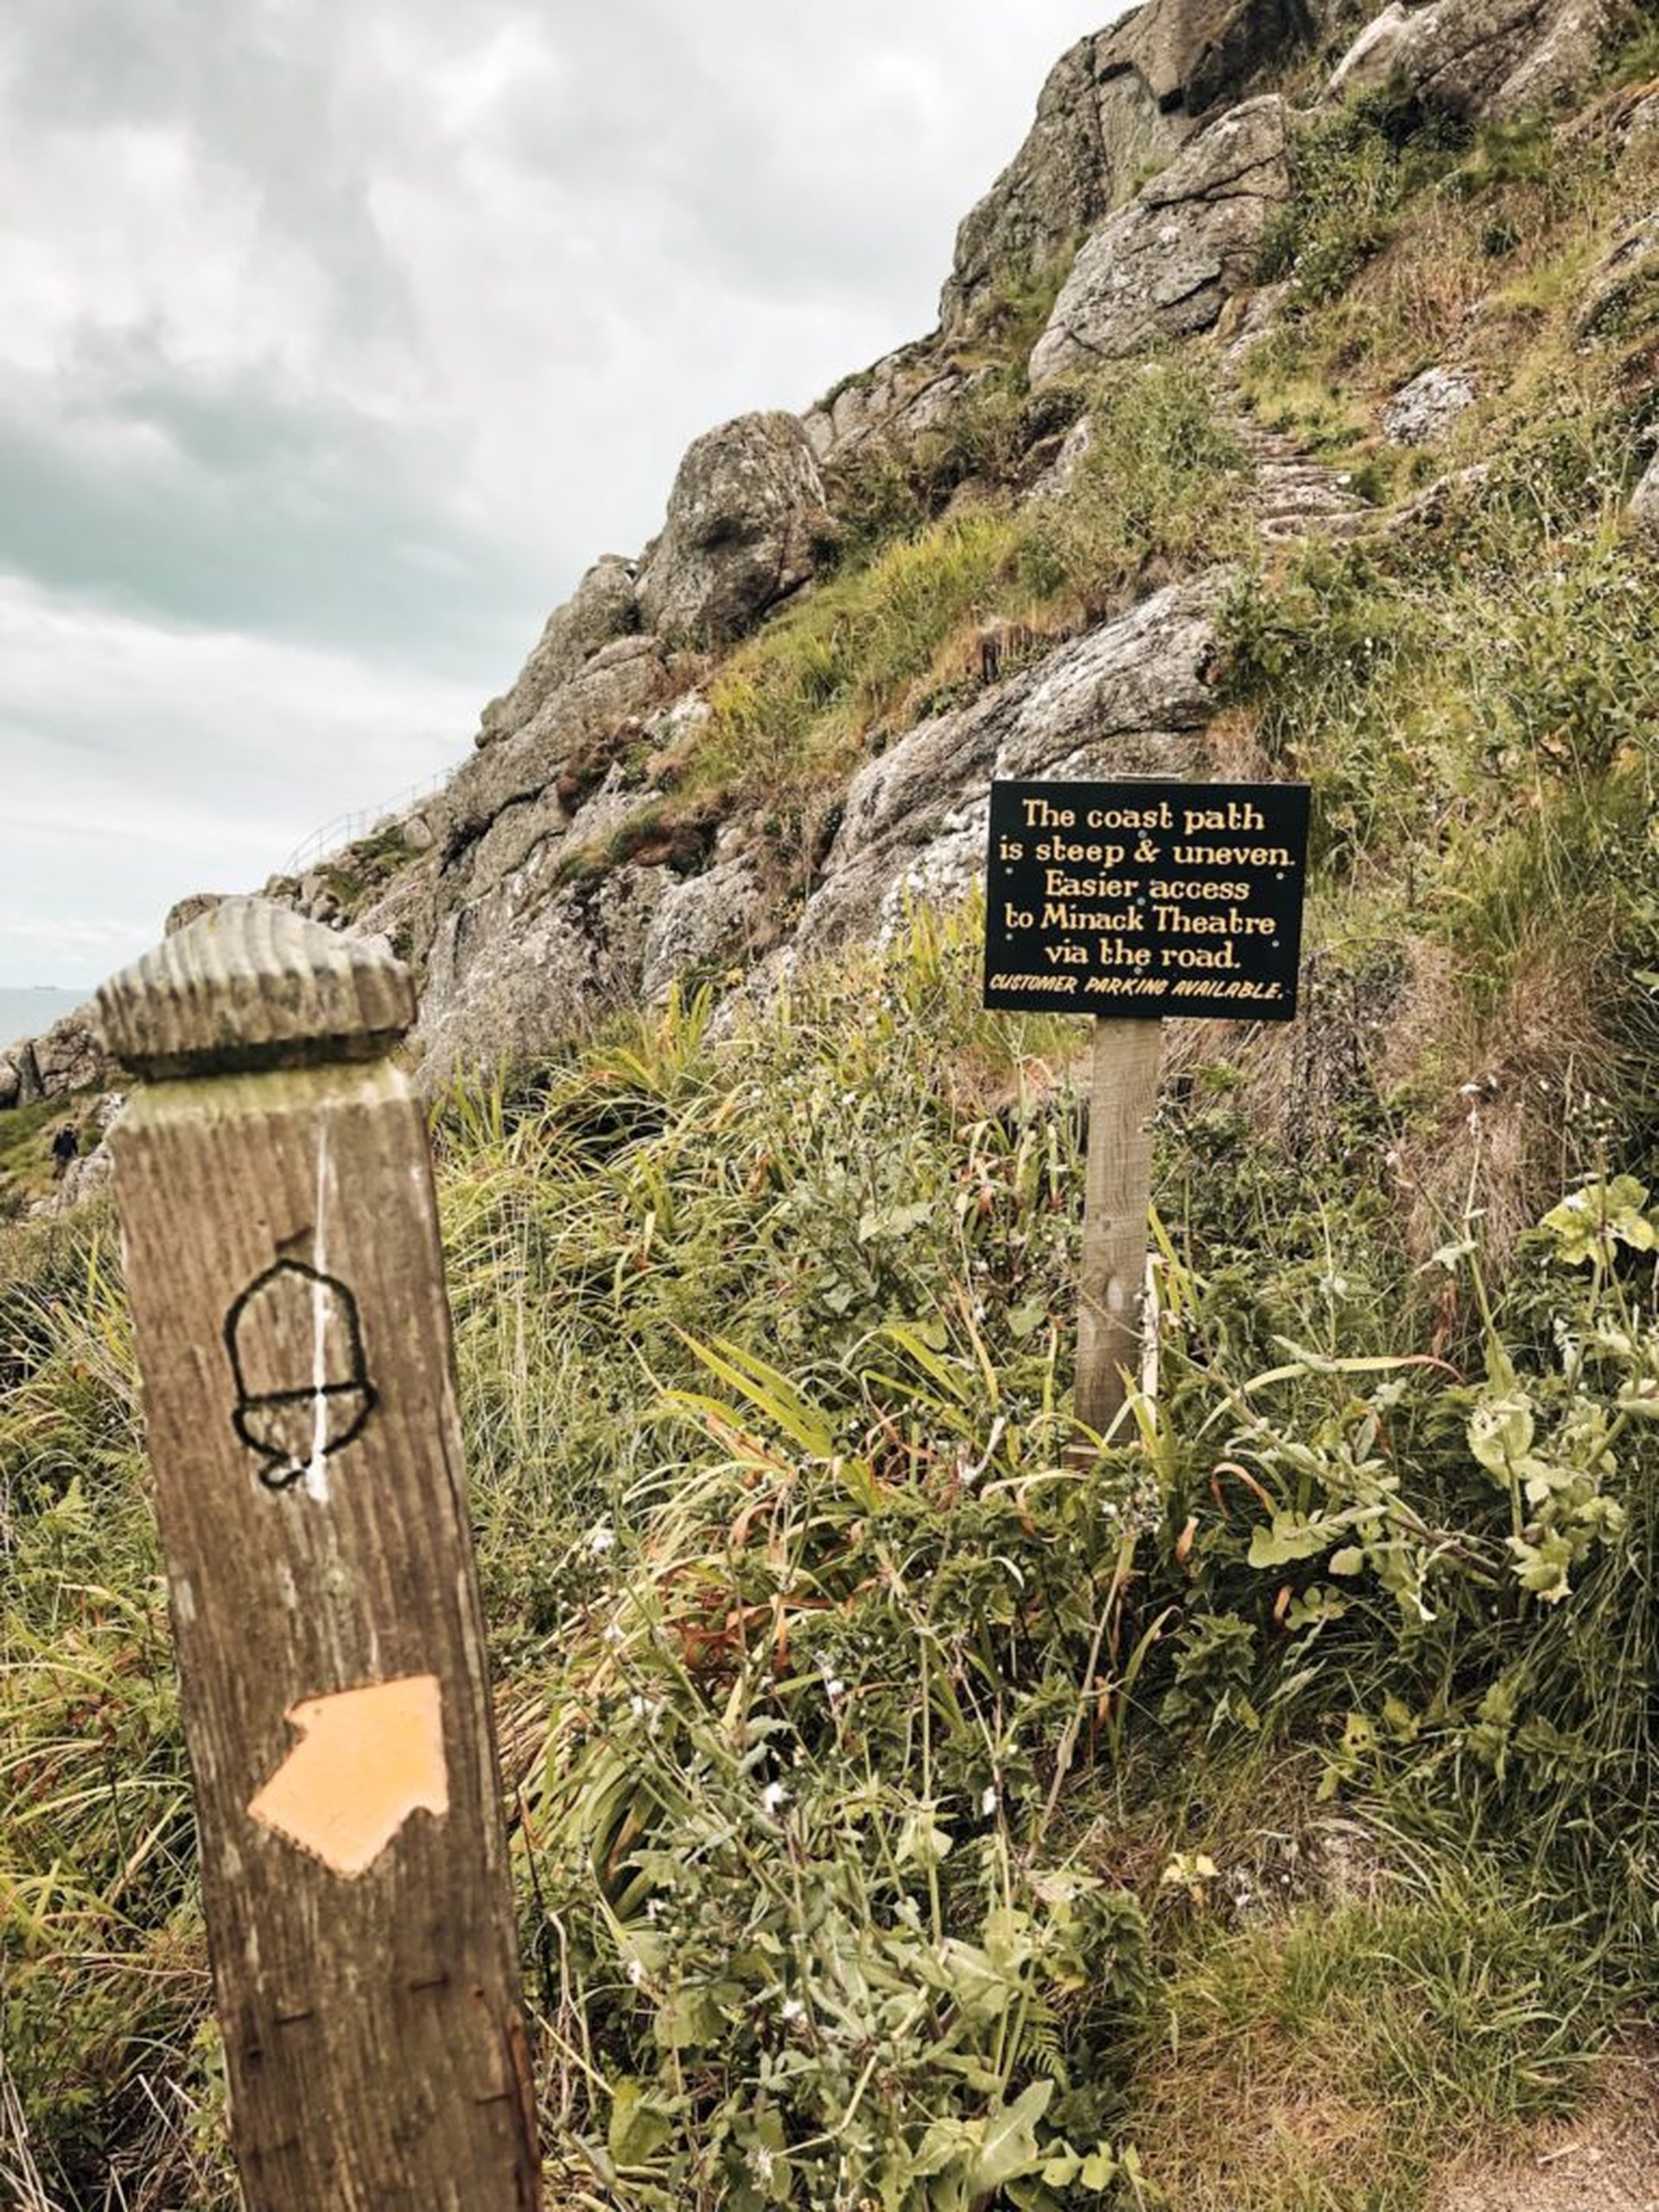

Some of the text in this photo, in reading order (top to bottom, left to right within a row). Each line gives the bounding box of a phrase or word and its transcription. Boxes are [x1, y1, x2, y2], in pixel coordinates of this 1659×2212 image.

[1022, 798, 1265, 836] The coast path
[1000, 835, 1296, 868] is steep & uneven.
[1045, 868, 1250, 900] Easier access
[1005, 903, 1276, 935] to Minack Theatre
[1045, 938, 1242, 969] via the road.
[988, 973, 1284, 1000] CUSTOMER PARKING AVAILABLE.
